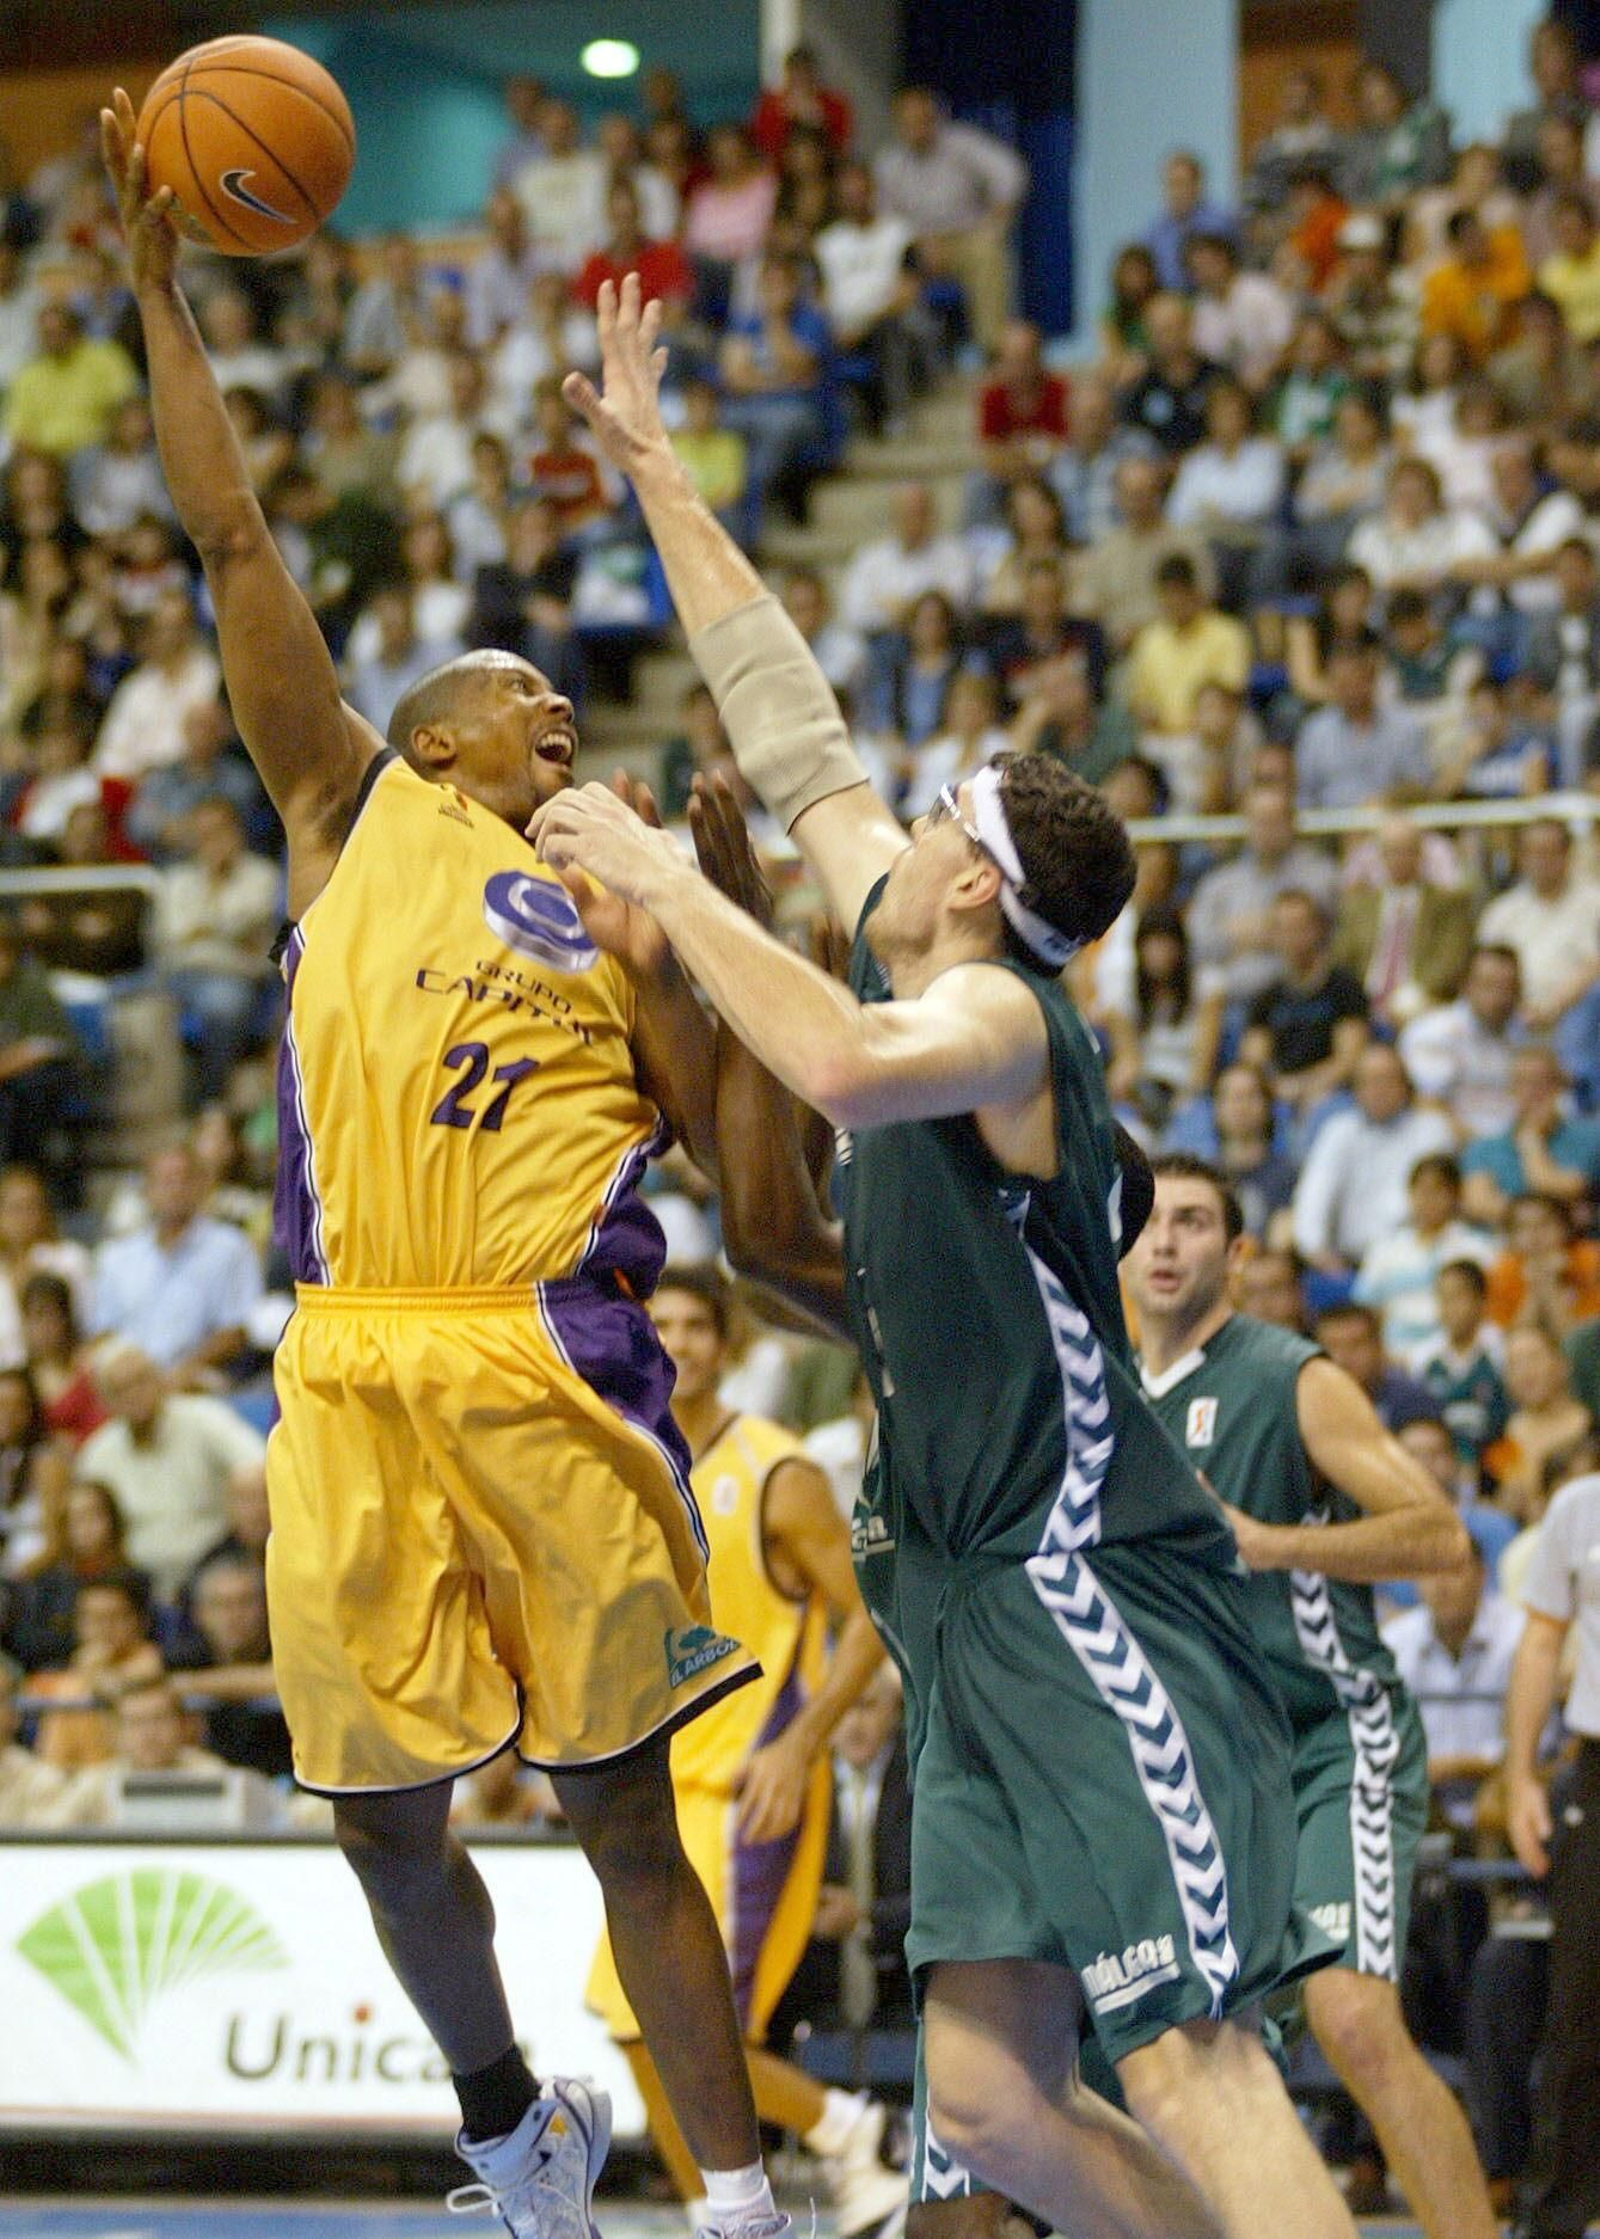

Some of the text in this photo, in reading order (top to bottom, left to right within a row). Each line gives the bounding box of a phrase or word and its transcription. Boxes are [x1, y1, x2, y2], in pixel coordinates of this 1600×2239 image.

[476, 960, 573, 1015] GRUPO
[430, 1042, 541, 1132] 21
[226, 2002, 532, 2083] Unica
